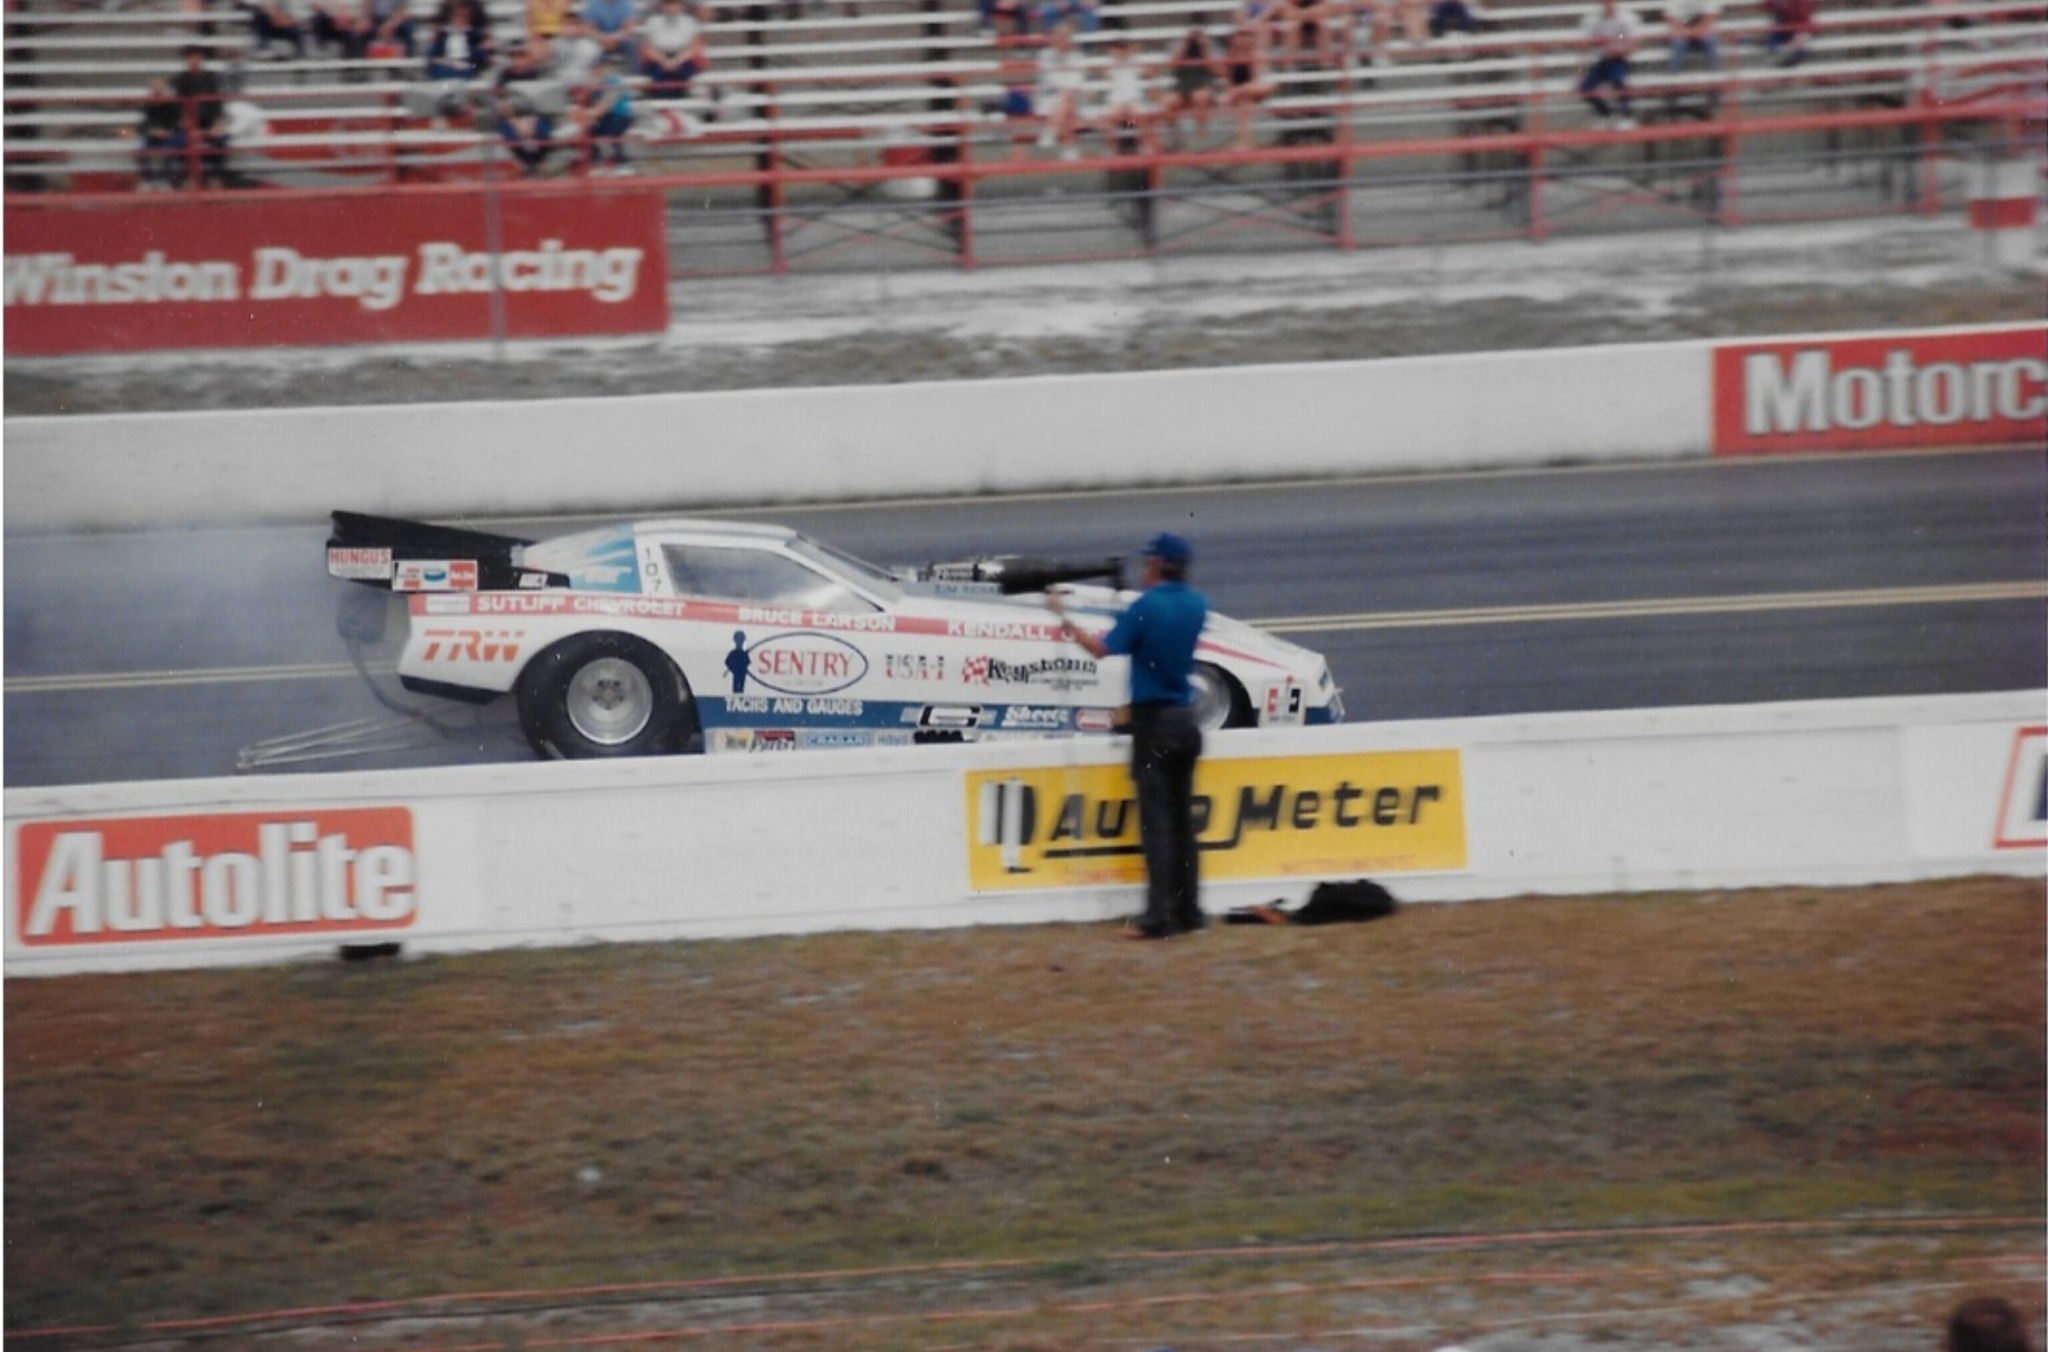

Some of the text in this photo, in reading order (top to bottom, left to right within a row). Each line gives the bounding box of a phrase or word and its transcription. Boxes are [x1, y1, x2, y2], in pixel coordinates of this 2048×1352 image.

[4, 239, 642, 310] Winston Drag Racing
[1744, 348, 2046, 437] Motorc
[573, 599, 686, 617] CHEVROLET
[738, 606, 896, 632] BRUCE LARSON
[947, 621, 1052, 640] KENDALL
[422, 630, 525, 663] TRW
[758, 649, 853, 677] SENTRY
[725, 698, 864, 717] TACHS AND GAUGES
[1050, 780, 1442, 848] Auo Meter
[27, 820, 418, 935] Autolite
